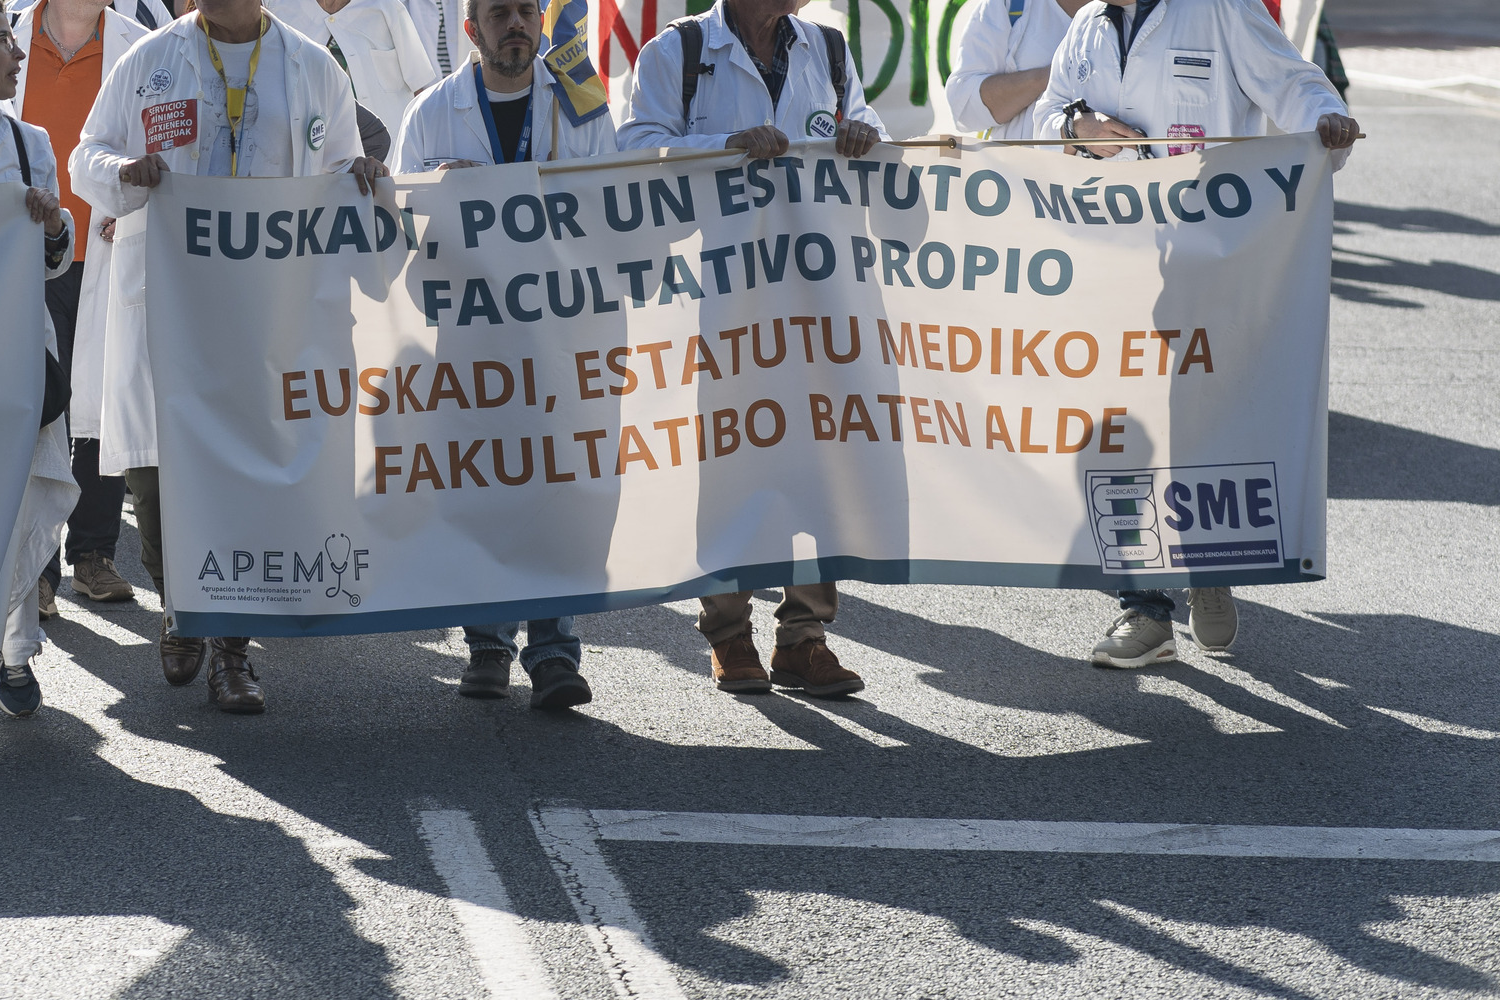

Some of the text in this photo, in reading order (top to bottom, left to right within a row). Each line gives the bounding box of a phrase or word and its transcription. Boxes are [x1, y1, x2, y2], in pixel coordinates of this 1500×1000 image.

[149, 100, 188, 117] SERVICIOS
[150, 109, 185, 124] MÍNIMOS
[147, 118, 193, 136] GUTXIENEKO
[311, 123, 325, 137] SME
[814, 116, 836, 134] SME
[147, 128, 192, 145] ZERBITZUAK
[185, 156, 1306, 261] EUSKADI, POR UN ESTATUTO MÉDICO Y
[422, 232, 1075, 328] FACULTATIVO PROPIO
[282, 315, 1215, 422] EUSKADI, ESTATUTU MEDIKO ETA
[373, 393, 1129, 496] FAKULTATIBO BATEN ALDE
[1105, 487, 1140, 496] SINDICATO
[1163, 478, 1277, 532] SME
[1113, 517, 1140, 527] MÉDICO
[1117, 549, 1145, 558] EUSKADI
[1172, 548, 1277, 560] EUSKADIKO SENDAGILEEN SINDIKATUA
[201, 585, 236, 593] Agrupación
[238, 594, 259, 602] Médico
